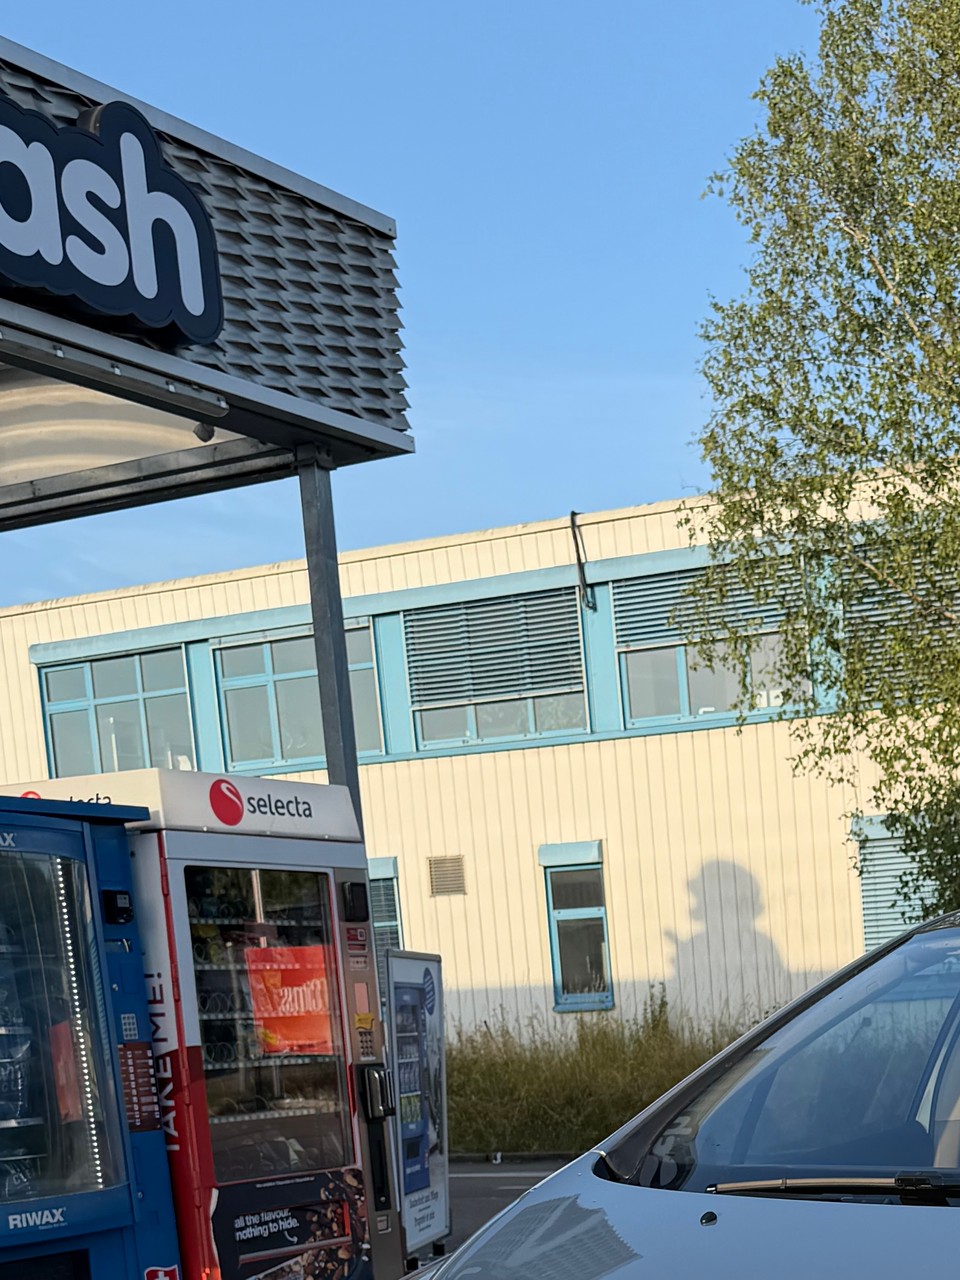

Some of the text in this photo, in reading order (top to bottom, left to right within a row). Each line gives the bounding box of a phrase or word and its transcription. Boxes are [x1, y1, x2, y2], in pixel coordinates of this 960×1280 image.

[247, 794, 313, 818] selecta
[8, 1208, 65, 1229] RIWAX
[234, 1216, 245, 1228] all
[245, 1213, 260, 1225] the
[235, 1216, 300, 1241] nothing to hide.
